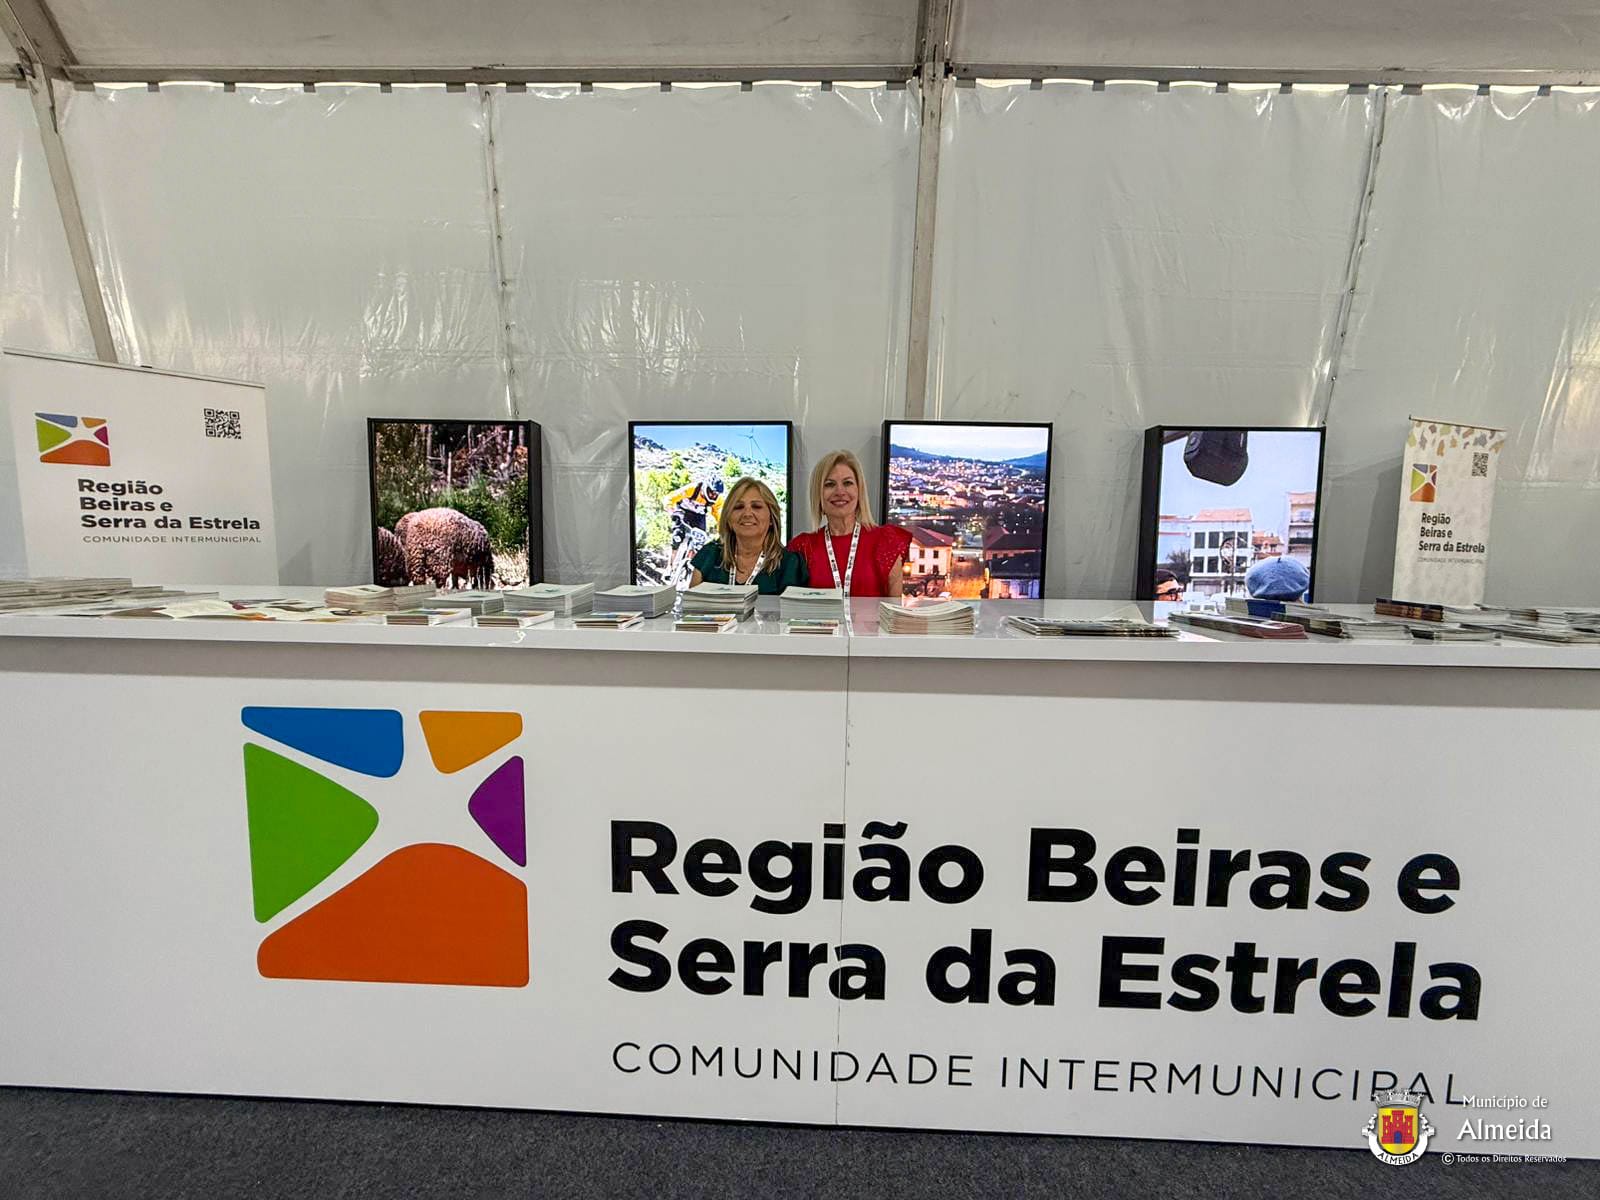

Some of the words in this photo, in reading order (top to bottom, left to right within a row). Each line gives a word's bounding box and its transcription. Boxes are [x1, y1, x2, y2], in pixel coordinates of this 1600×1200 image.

[77, 478, 163, 496] Região
[79, 496, 156, 512] Beiras
[159, 500, 173, 512] e
[81, 514, 147, 529] Serra
[154, 515, 182, 530] da
[189, 516, 261, 530] Estrela
[1421, 512, 1451, 526] Região
[83, 535, 167, 543] COMUNIDADE
[171, 535, 262, 543] INTERMUNICIPAL
[1420, 526, 1446, 538] Beiras
[1447, 529, 1453, 538] e
[1418, 540, 1441, 552] Serra
[1442, 541, 1454, 552] da
[1456, 542, 1485, 553] Estrela
[610, 819, 984, 915] Região
[1027, 827, 1372, 912] Beiras
[1397, 853, 1461, 915] e
[607, 919, 887, 1001] Serra
[925, 928, 1056, 1006] da
[1098, 935, 1482, 1021] Estrela
[612, 1041, 974, 1088] COMUNIDADE
[1000, 1056, 1468, 1106] INTERMUNICIPAL
